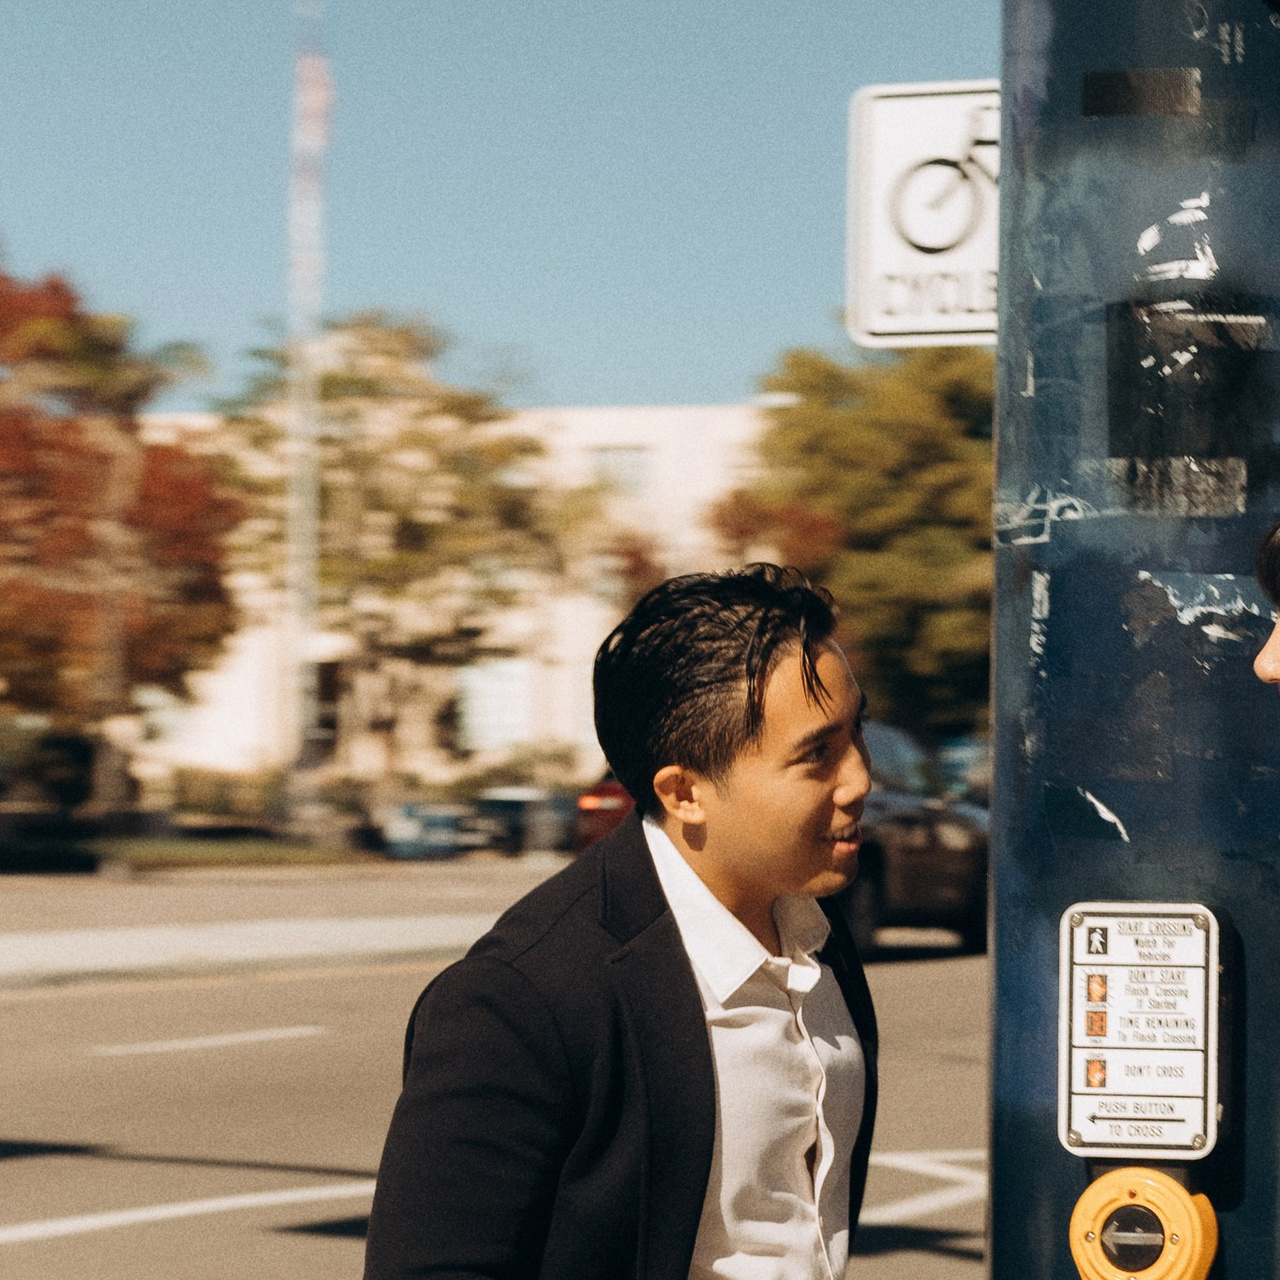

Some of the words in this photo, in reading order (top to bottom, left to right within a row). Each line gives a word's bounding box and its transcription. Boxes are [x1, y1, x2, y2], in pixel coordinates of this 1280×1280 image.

[1156, 1065, 1185, 1078] CROSS
[1098, 1101, 1127, 1113] PUSH
[1133, 1102, 1175, 1115] BUTTON
[1109, 1124, 1122, 1137] TO
[1127, 1125, 1164, 1137] CROSS
